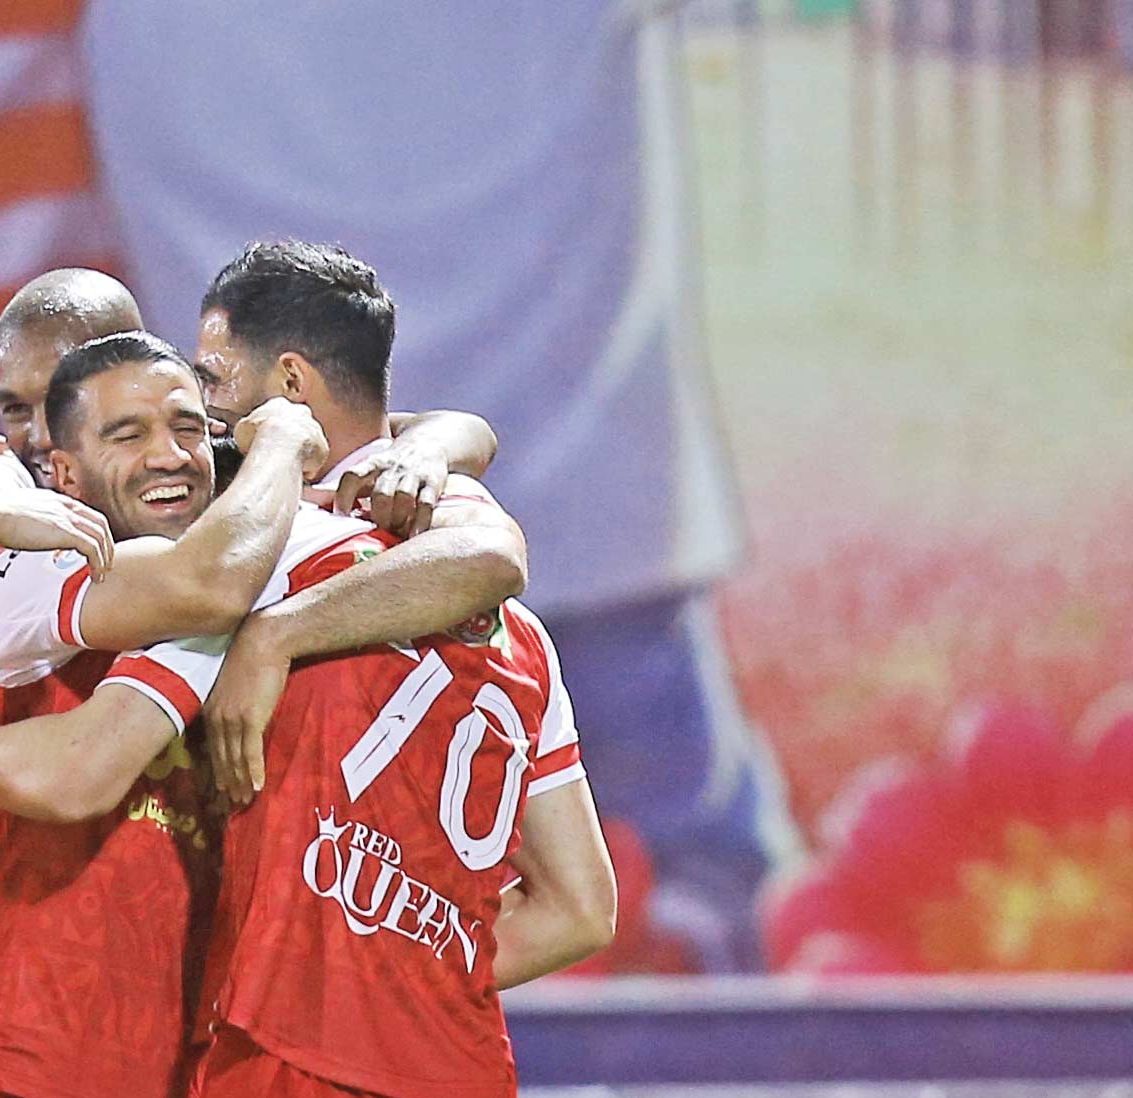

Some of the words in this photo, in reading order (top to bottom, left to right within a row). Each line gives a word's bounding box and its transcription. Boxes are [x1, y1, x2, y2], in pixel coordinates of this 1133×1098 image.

[340, 640, 530, 871] 70
[302, 830, 482, 974] QUEEN
[350, 822, 402, 866] RED
